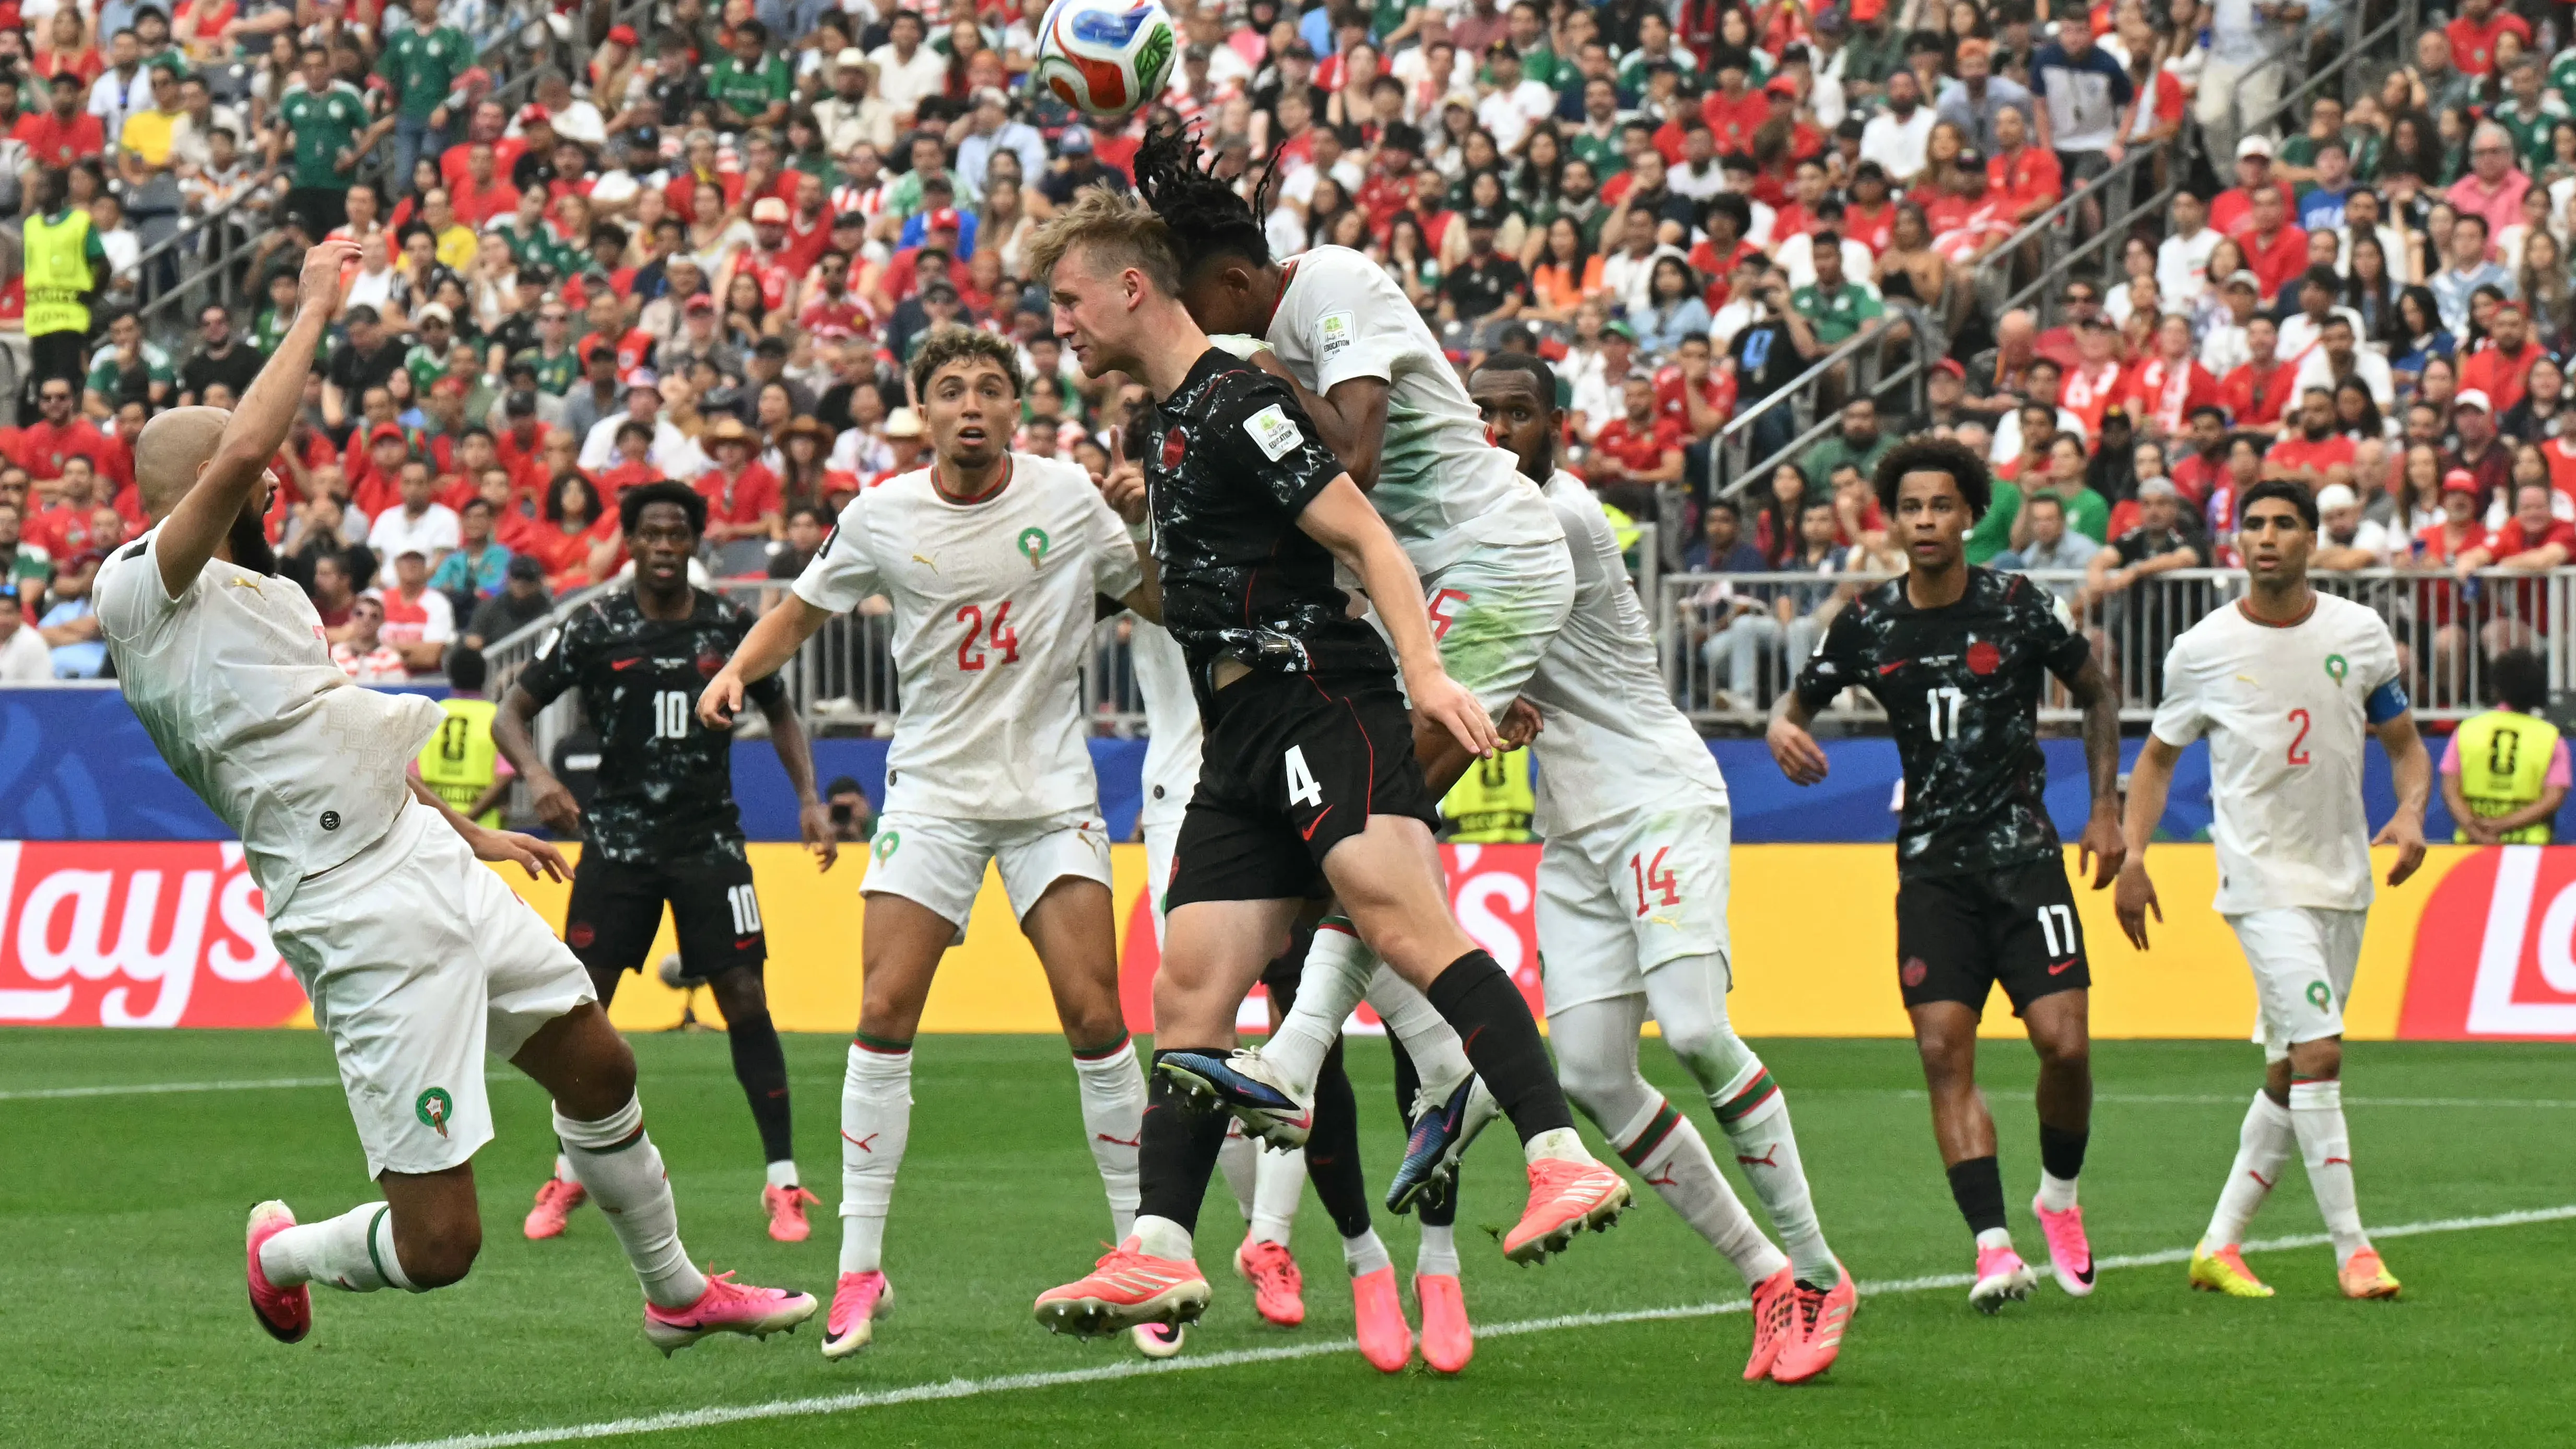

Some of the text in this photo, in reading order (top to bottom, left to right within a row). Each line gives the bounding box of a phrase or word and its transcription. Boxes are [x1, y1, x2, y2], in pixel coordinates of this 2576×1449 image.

[1323, 339, 1350, 352] EDUCATION
[1268, 429, 1293, 449] EDUCATION
[957, 601, 1018, 671] 24
[653, 690, 688, 739] 10
[1927, 687, 1962, 741] 17
[2287, 708, 2310, 765] 2
[1285, 745, 1322, 807] 4
[1630, 846, 1680, 917] 14
[727, 884, 761, 934] 10
[2037, 904, 2076, 958] 17
